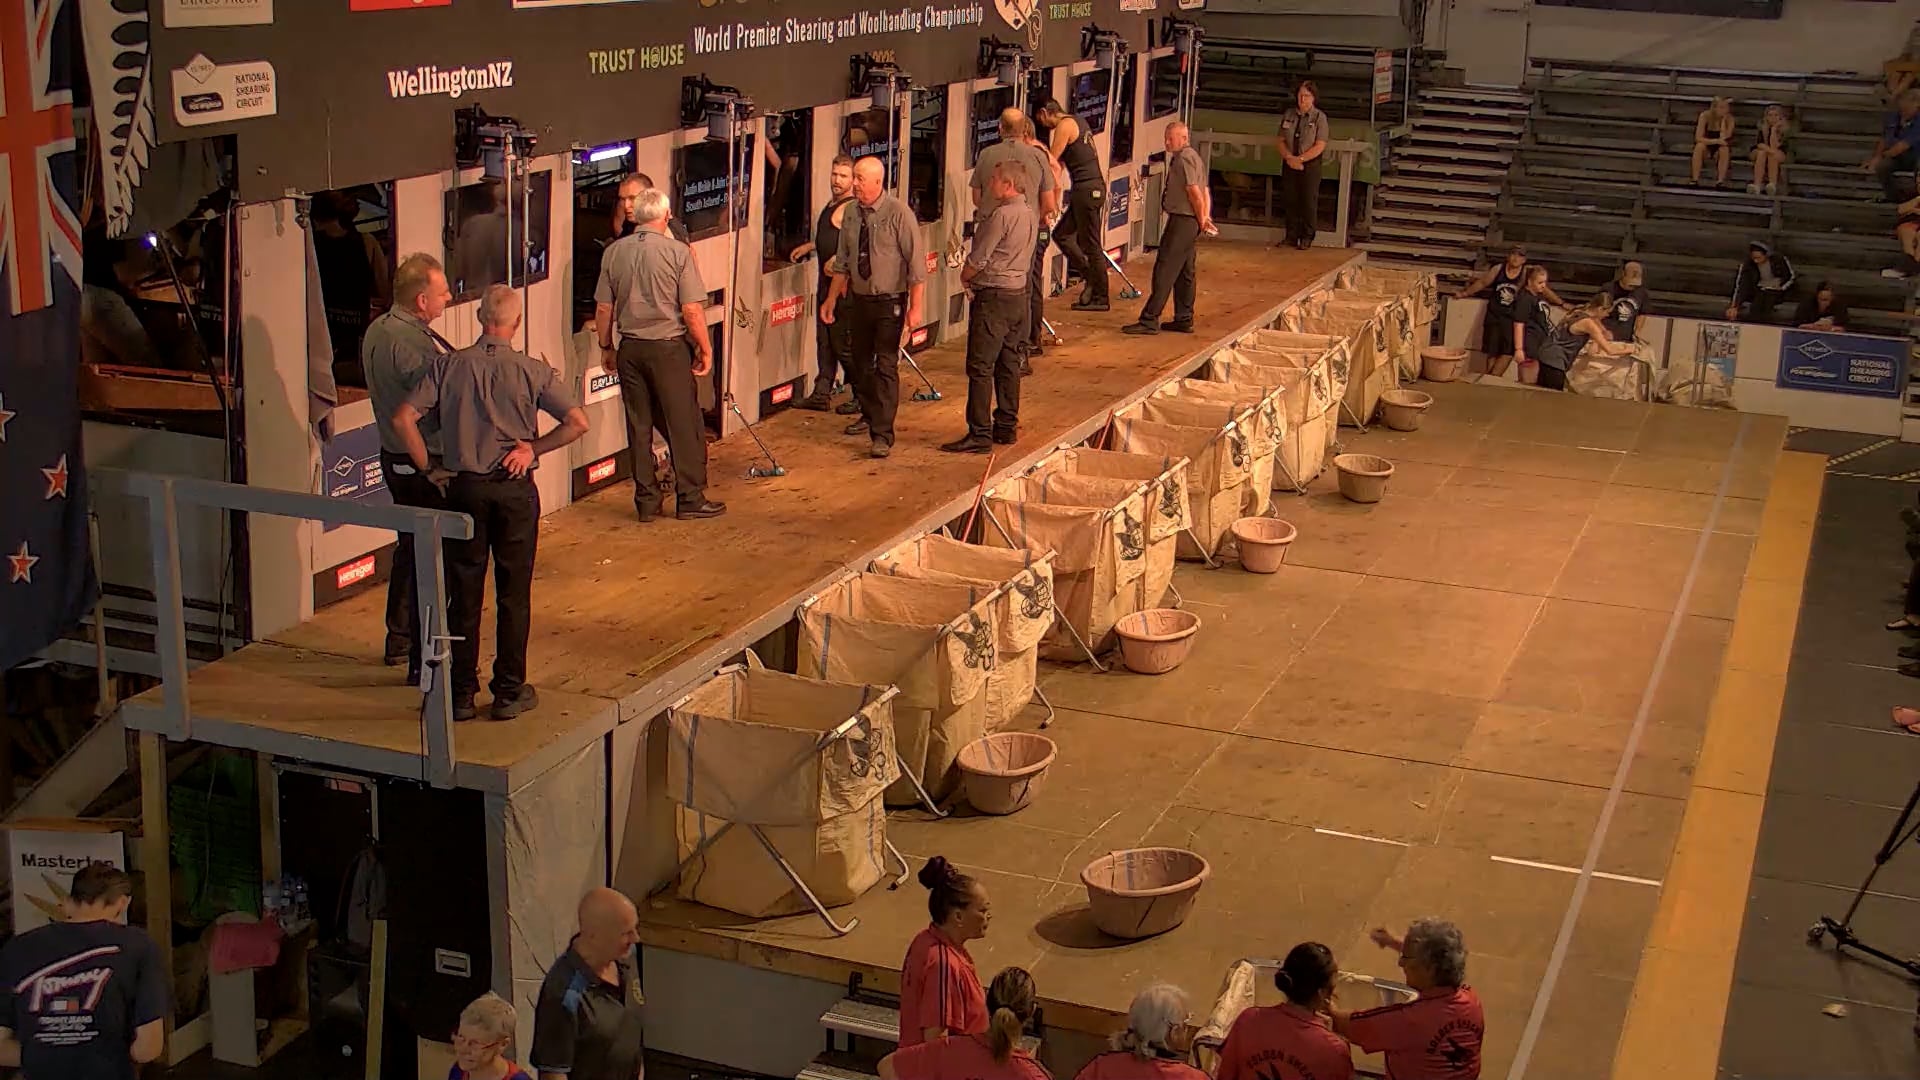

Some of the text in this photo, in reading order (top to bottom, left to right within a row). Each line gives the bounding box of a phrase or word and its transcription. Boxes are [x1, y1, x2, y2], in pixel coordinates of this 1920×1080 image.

[1049, 2, 1092, 20] TRUST HOUSE
[693, 1, 984, 54] World Premier Shearing and Woolhandling Championship
[588, 43, 685, 74] TRUST HOUSE
[235, 71, 270, 84] NATIONAL
[387, 61, 513, 98] WellingtonNZ
[235, 83, 271, 96] SHEARING
[236, 96, 263, 108] CIRCUIT
[1849, 358, 1892, 369] NATIONAL
[1849, 366, 1892, 377] SHEARING
[1847, 374, 1880, 384] CIRCUIT
